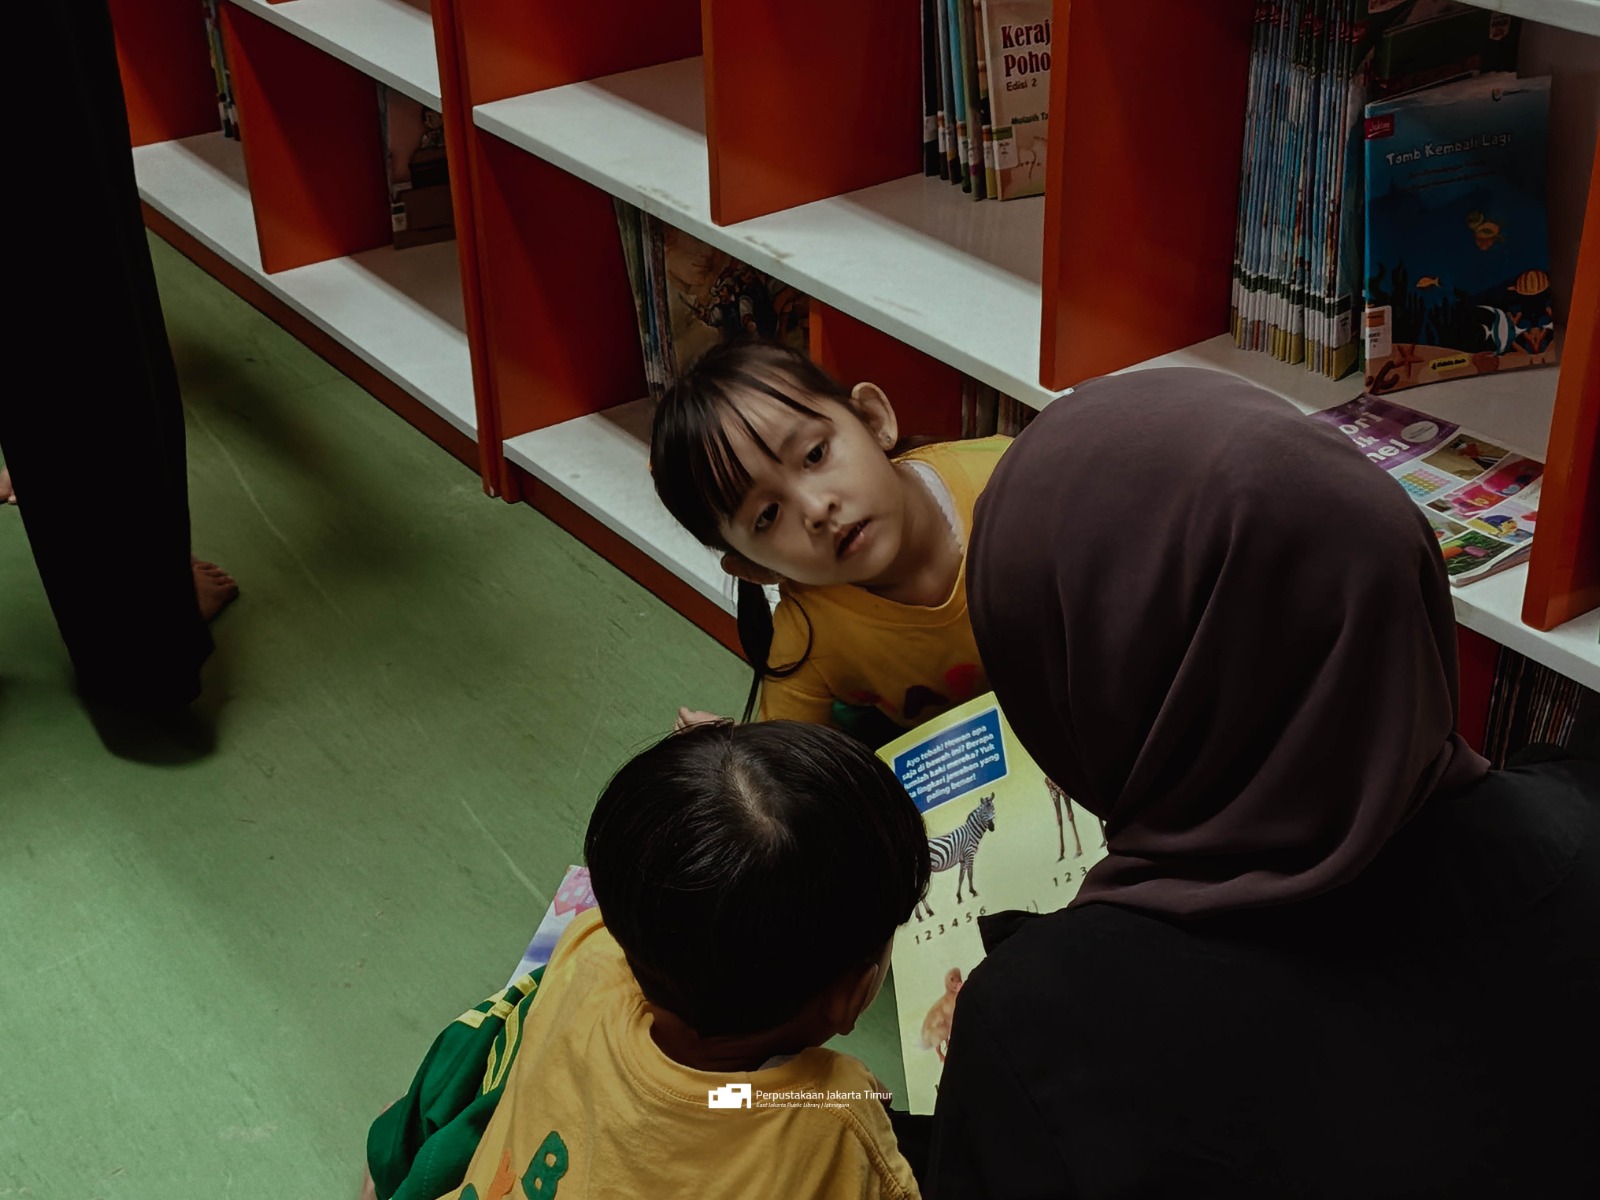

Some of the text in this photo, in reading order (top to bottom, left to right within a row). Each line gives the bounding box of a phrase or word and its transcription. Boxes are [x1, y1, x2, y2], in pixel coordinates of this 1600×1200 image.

[1001, 19, 1051, 49] Keraj
[1004, 51, 1051, 77] Poho
[1006, 78, 1037, 92] Edisi 2
[1424, 138, 1478, 158] Kembali
[1482, 132, 1512, 147] Lagi
[901, 733, 994, 781] saja di bawah ini? Berapa
[906, 756, 921, 768] Ayo
[945, 732, 971, 748] Hewan
[971, 725, 987, 737] apa
[929, 765, 946, 778] kaki
[947, 749, 979, 770] mereka?
[979, 742, 996, 754] Yuk
[917, 775, 946, 795] lingkari
[947, 762, 979, 783] jawaban
[979, 752, 1000, 768] yang
[926, 772, 977, 803] paling benar!
[1053, 866, 1087, 886] 1 2 3
[915, 906, 986, 944] 1 2 3 4 5 6
